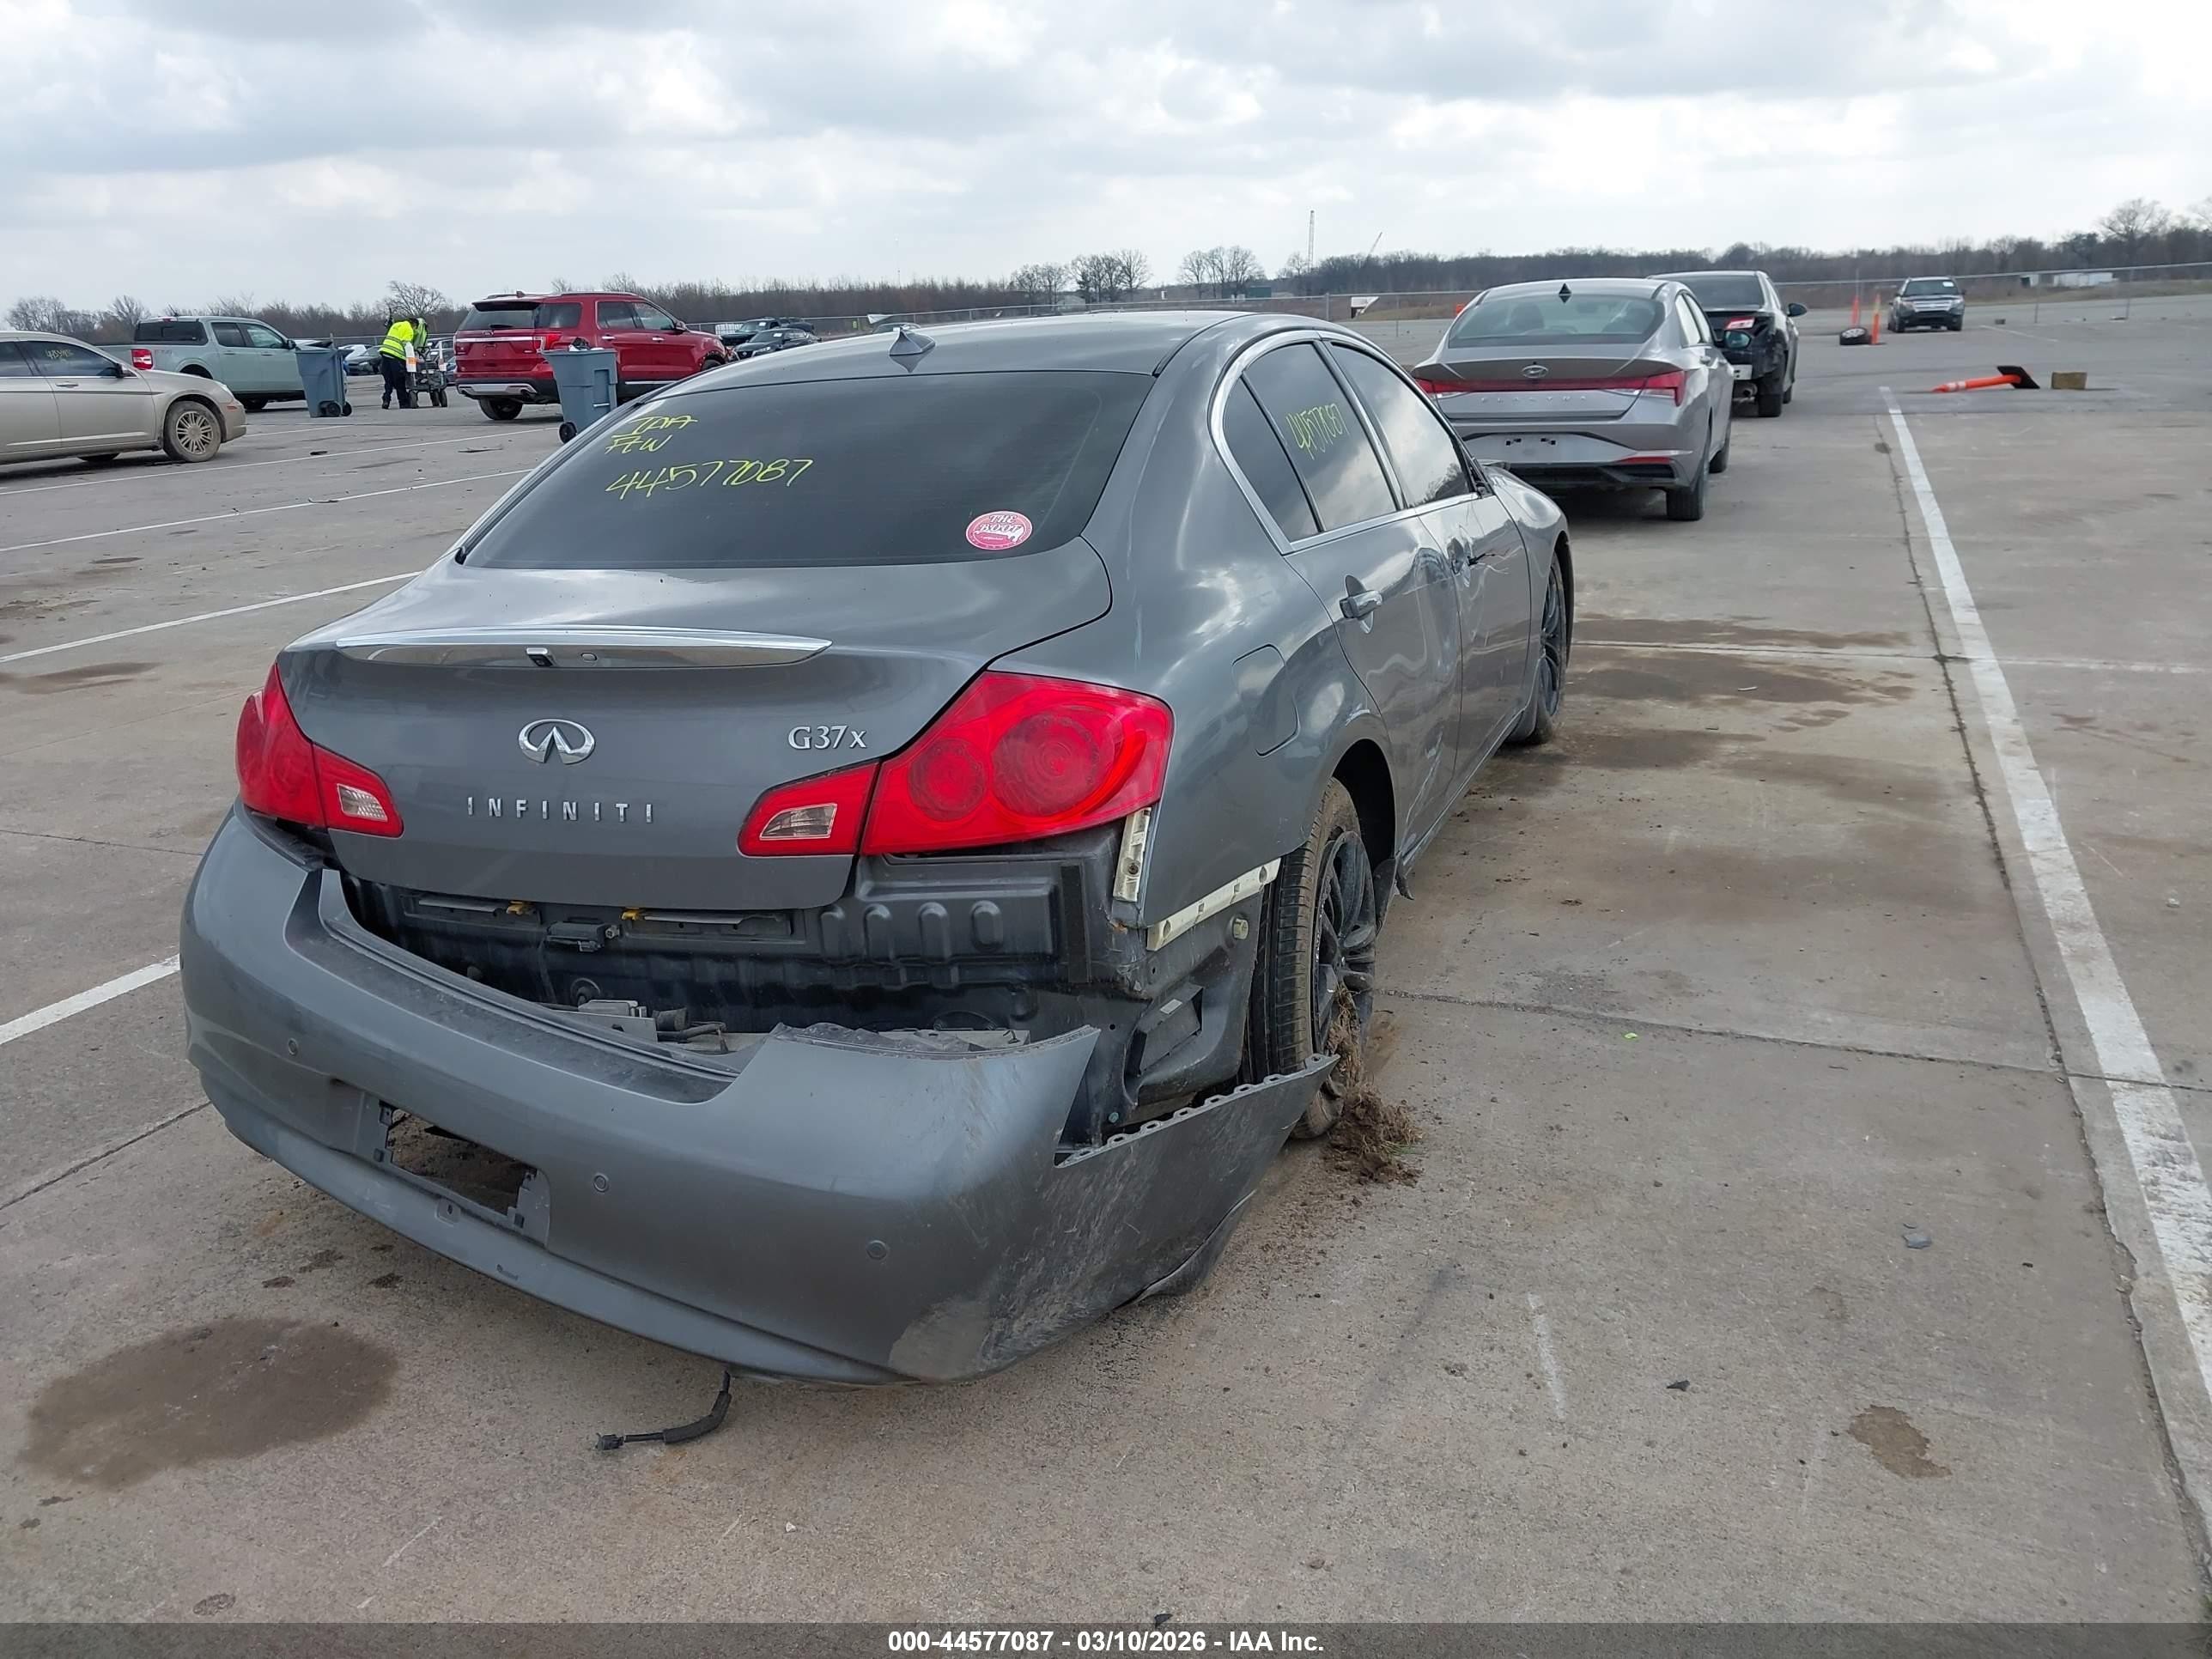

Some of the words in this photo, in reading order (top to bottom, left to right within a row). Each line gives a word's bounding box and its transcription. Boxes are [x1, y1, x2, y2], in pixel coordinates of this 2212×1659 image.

[605, 459, 814, 500] 44577087
[989, 514, 1017, 523] THE
[787, 725, 867, 750] G37x
[467, 796, 653, 823] INFINITI
